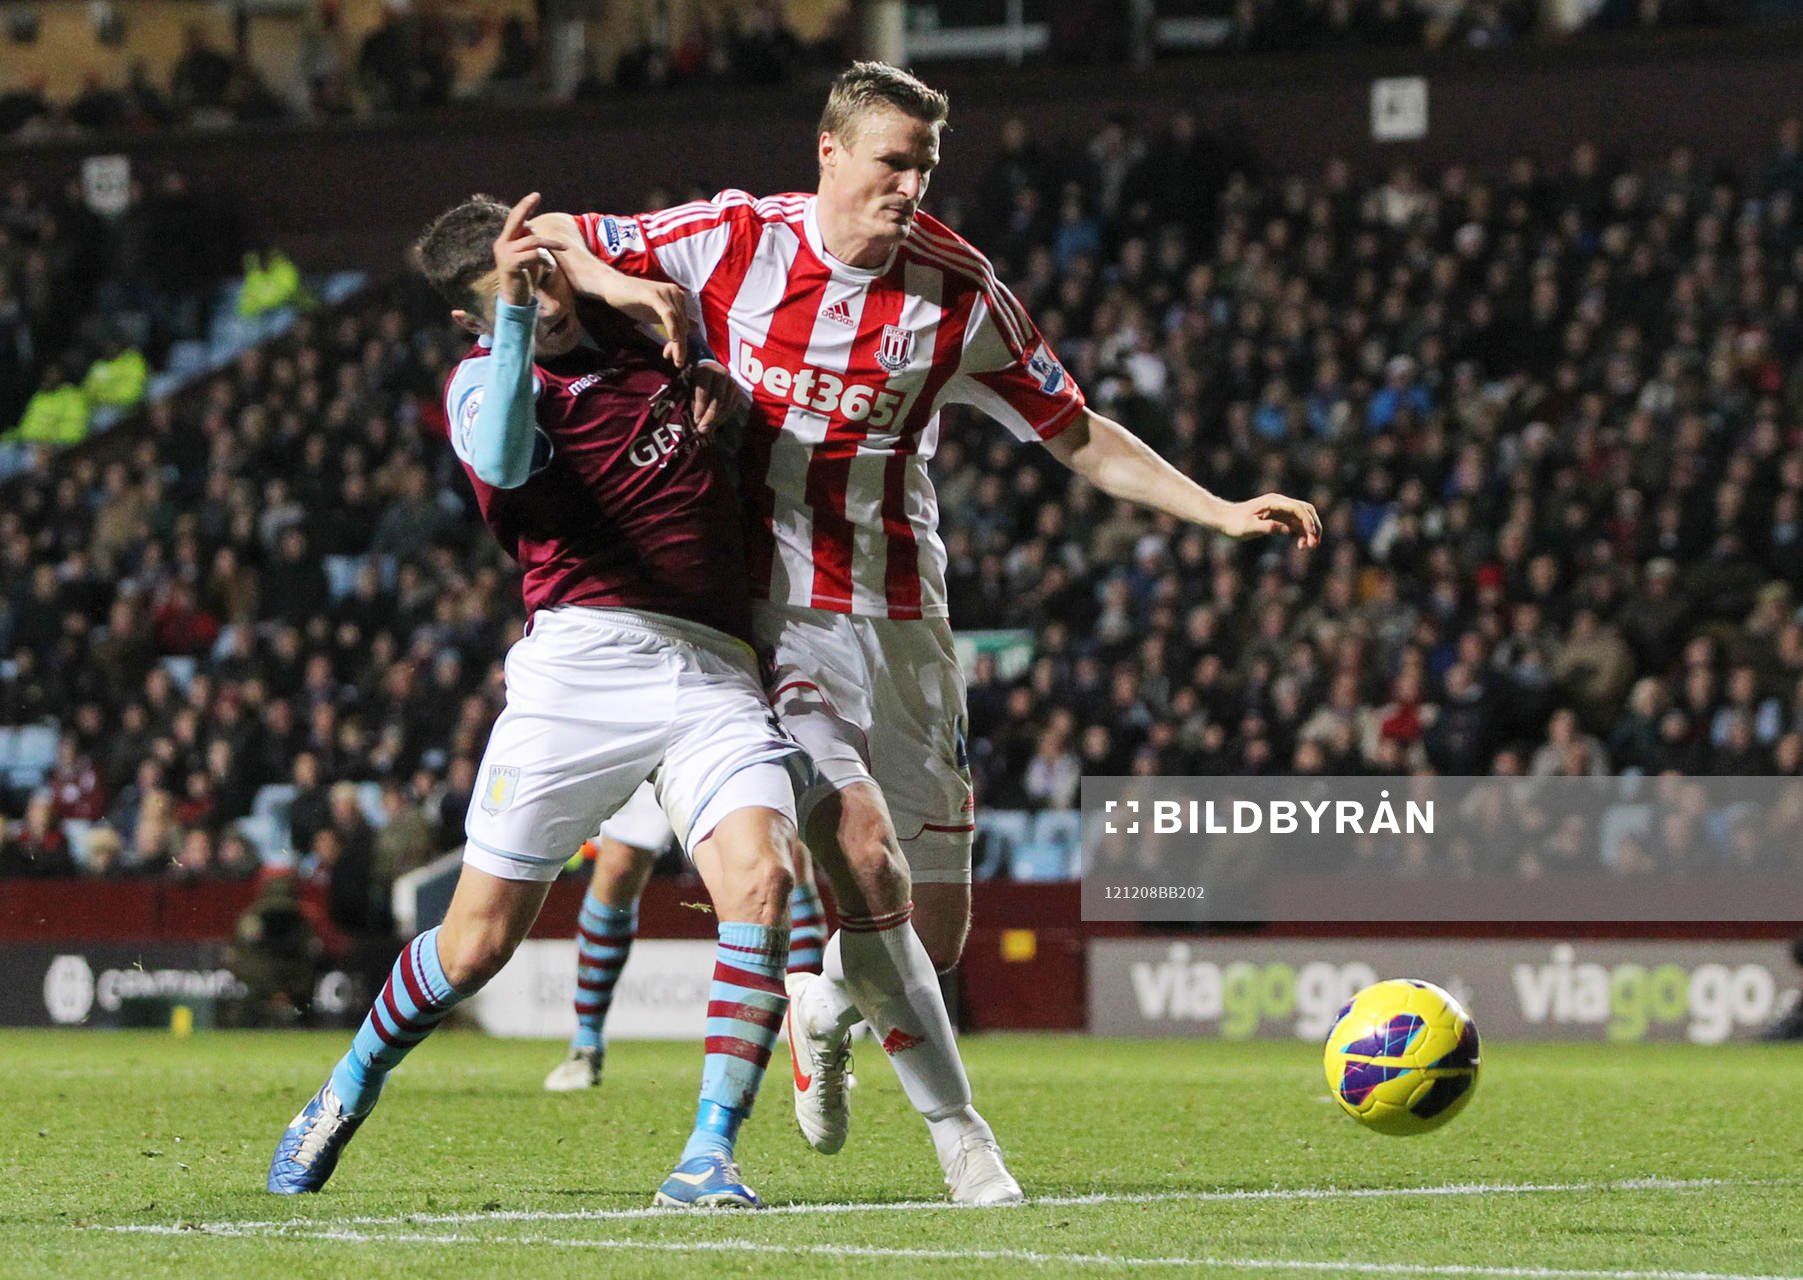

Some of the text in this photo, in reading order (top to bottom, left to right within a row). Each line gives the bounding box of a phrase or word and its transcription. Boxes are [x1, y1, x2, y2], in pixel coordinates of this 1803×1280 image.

[821, 310, 854, 326] adidas
[740, 343, 900, 428] bet365
[491, 767, 517, 777] AVFC
[1131, 942, 1379, 1041] viagogo
[1512, 943, 1777, 1044] viagogo
